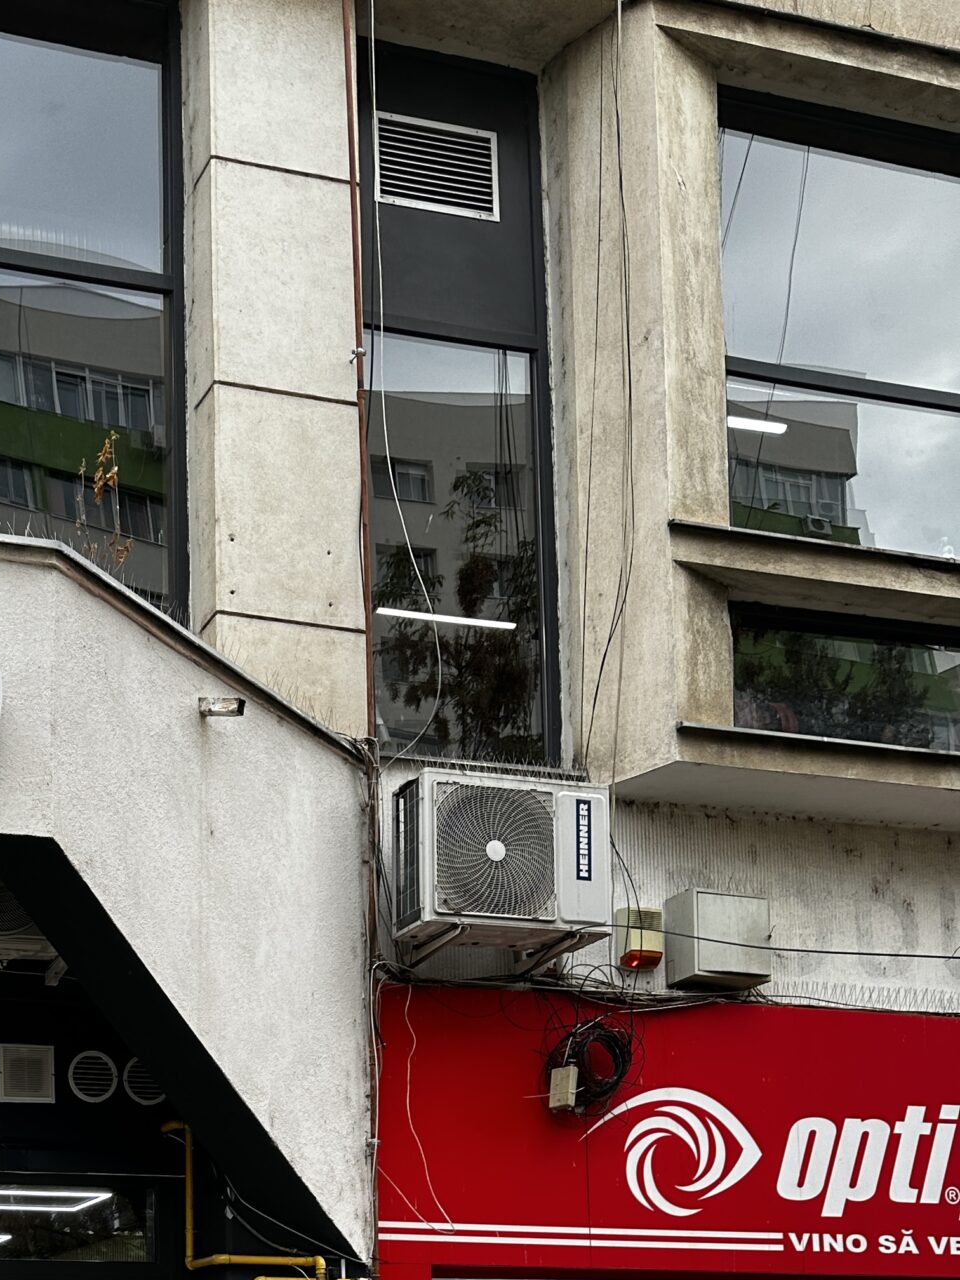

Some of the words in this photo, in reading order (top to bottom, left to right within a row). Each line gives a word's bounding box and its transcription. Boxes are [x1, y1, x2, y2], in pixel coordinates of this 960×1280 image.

[577, 802, 591, 879] HEINNER
[776, 1104, 960, 1218] opti
[789, 1232, 868, 1254] VINO
[878, 1229, 919, 1256] SĂ
